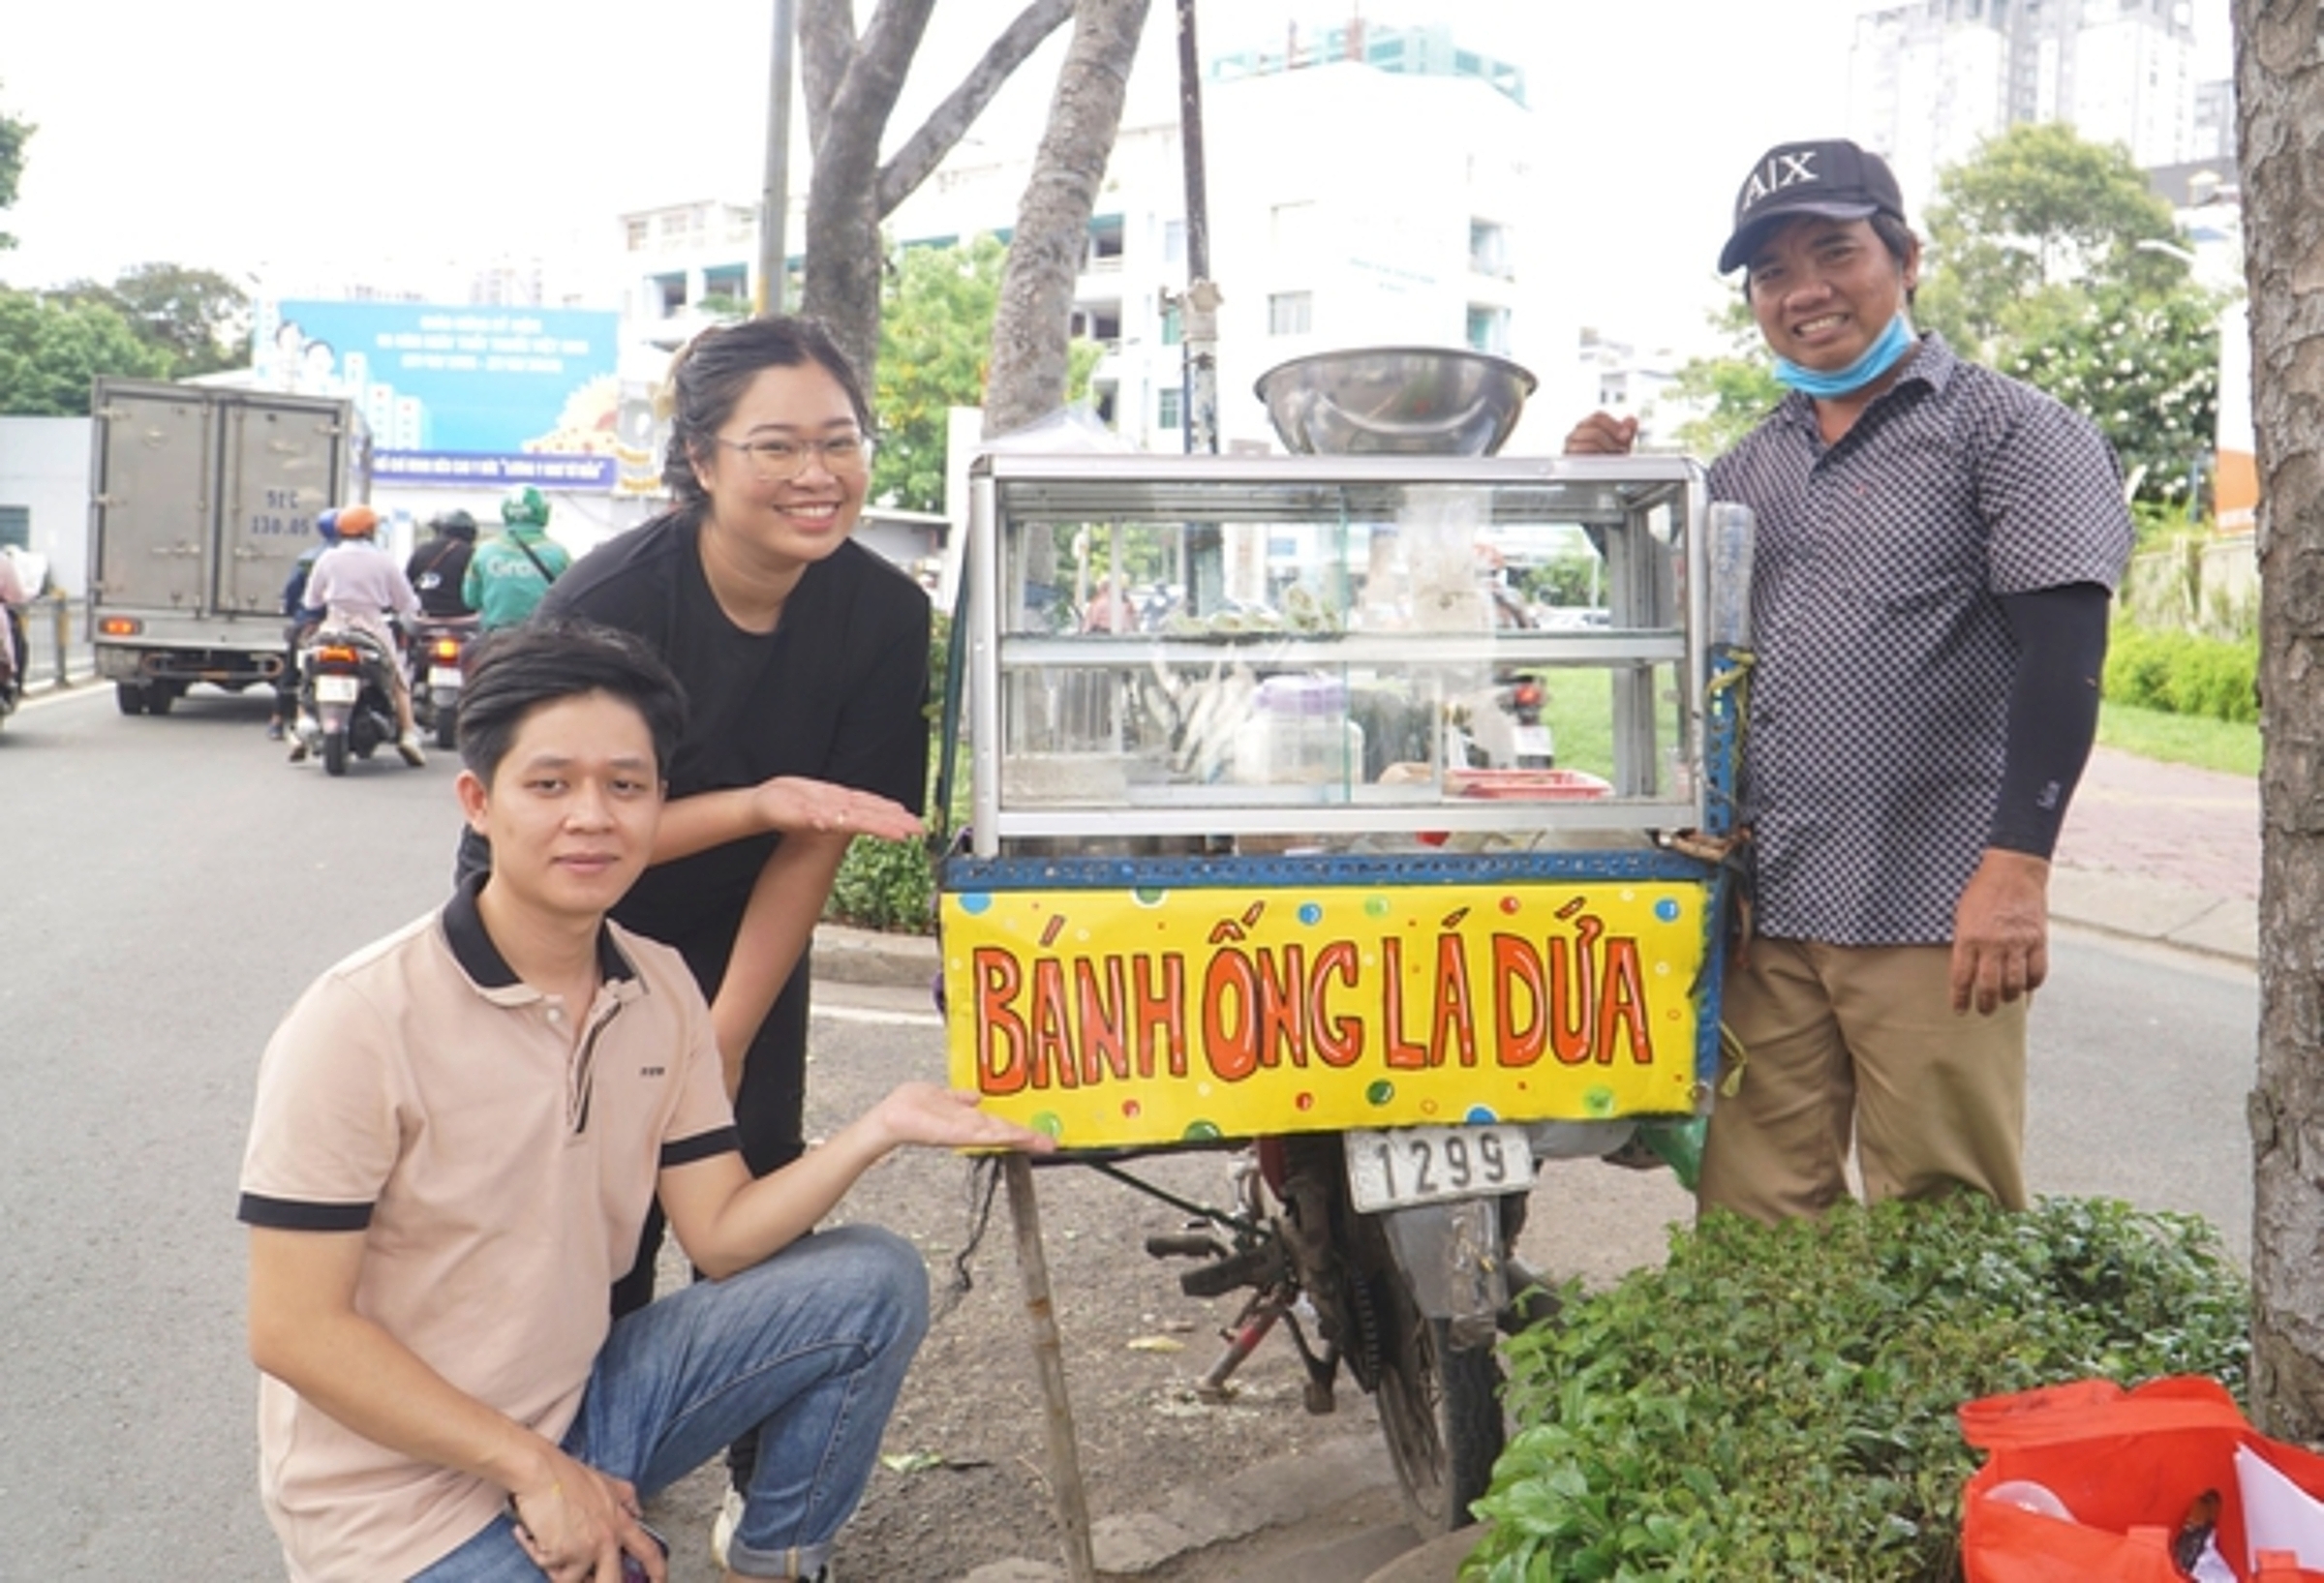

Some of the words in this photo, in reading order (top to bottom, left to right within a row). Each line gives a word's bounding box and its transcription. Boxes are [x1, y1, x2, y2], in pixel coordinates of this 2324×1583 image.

[972, 914, 1189, 1095] BÁNH
[1202, 900, 1363, 1081] ỐNG
[1383, 907, 1477, 1070] LÁ
[1492, 897, 1653, 1069] DỨA
[1374, 1133, 1506, 1199] 1299
